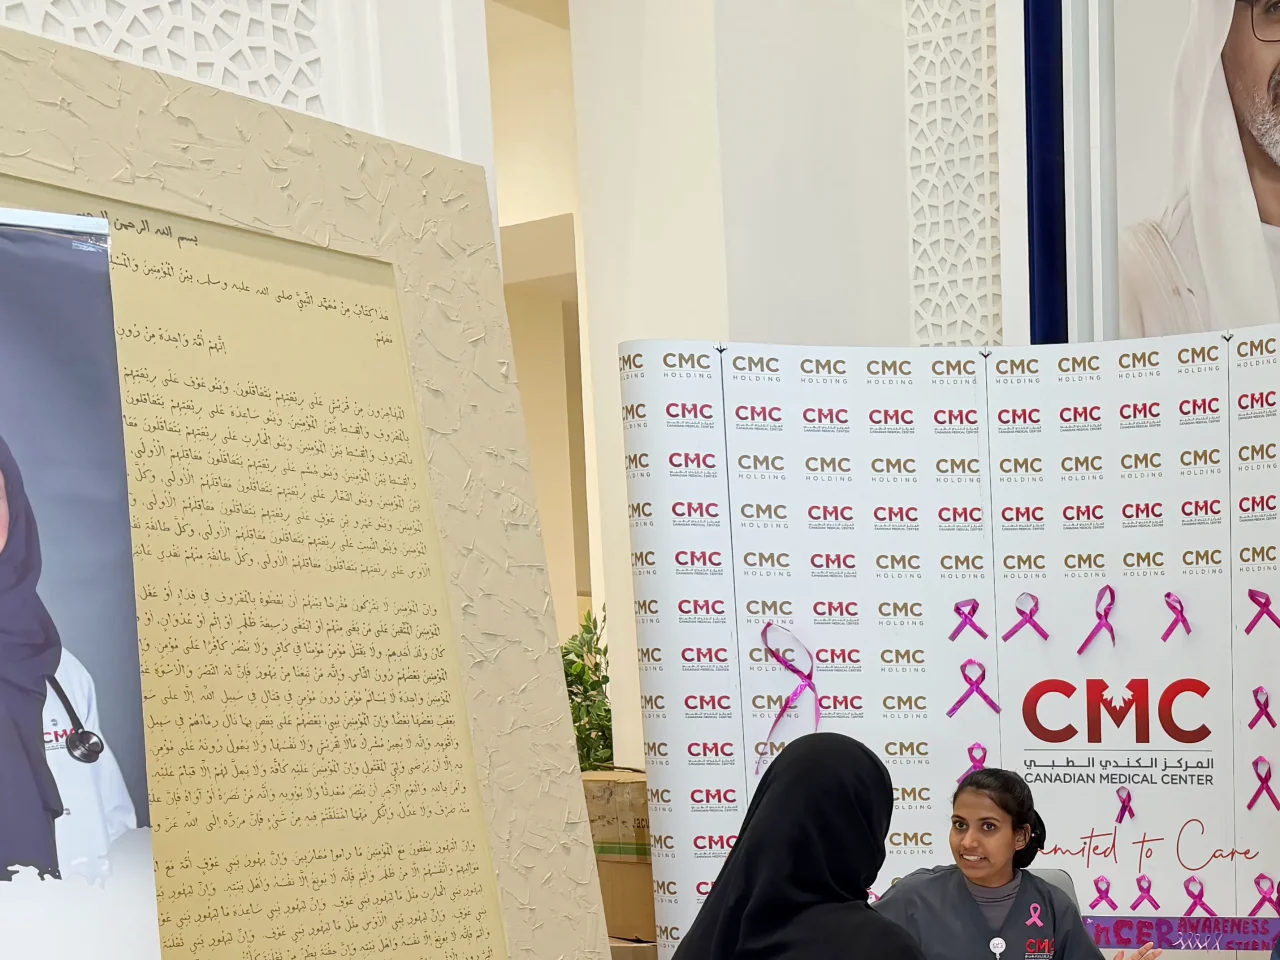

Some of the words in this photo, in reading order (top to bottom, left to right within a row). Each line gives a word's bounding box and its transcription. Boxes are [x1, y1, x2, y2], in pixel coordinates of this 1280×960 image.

[662, 353, 711, 370] CMC
[732, 356, 780, 372] CMC
[996, 359, 1039, 375] CMC
[869, 409, 914, 425] CMC
[1022, 677, 1212, 744] CMC
[1024, 757, 1095, 770] الطبي
[1099, 757, 1157, 770] الكندي
[1162, 758, 1214, 771] المركز
[1024, 773, 1095, 784] CANADIAN
[1099, 773, 1157, 784] MEDICAL
[1161, 774, 1214, 785] CENTER
[1132, 832, 1164, 873] to
[1175, 818, 1261, 872] Care
[1177, 918, 1270, 935] AWARENESS
